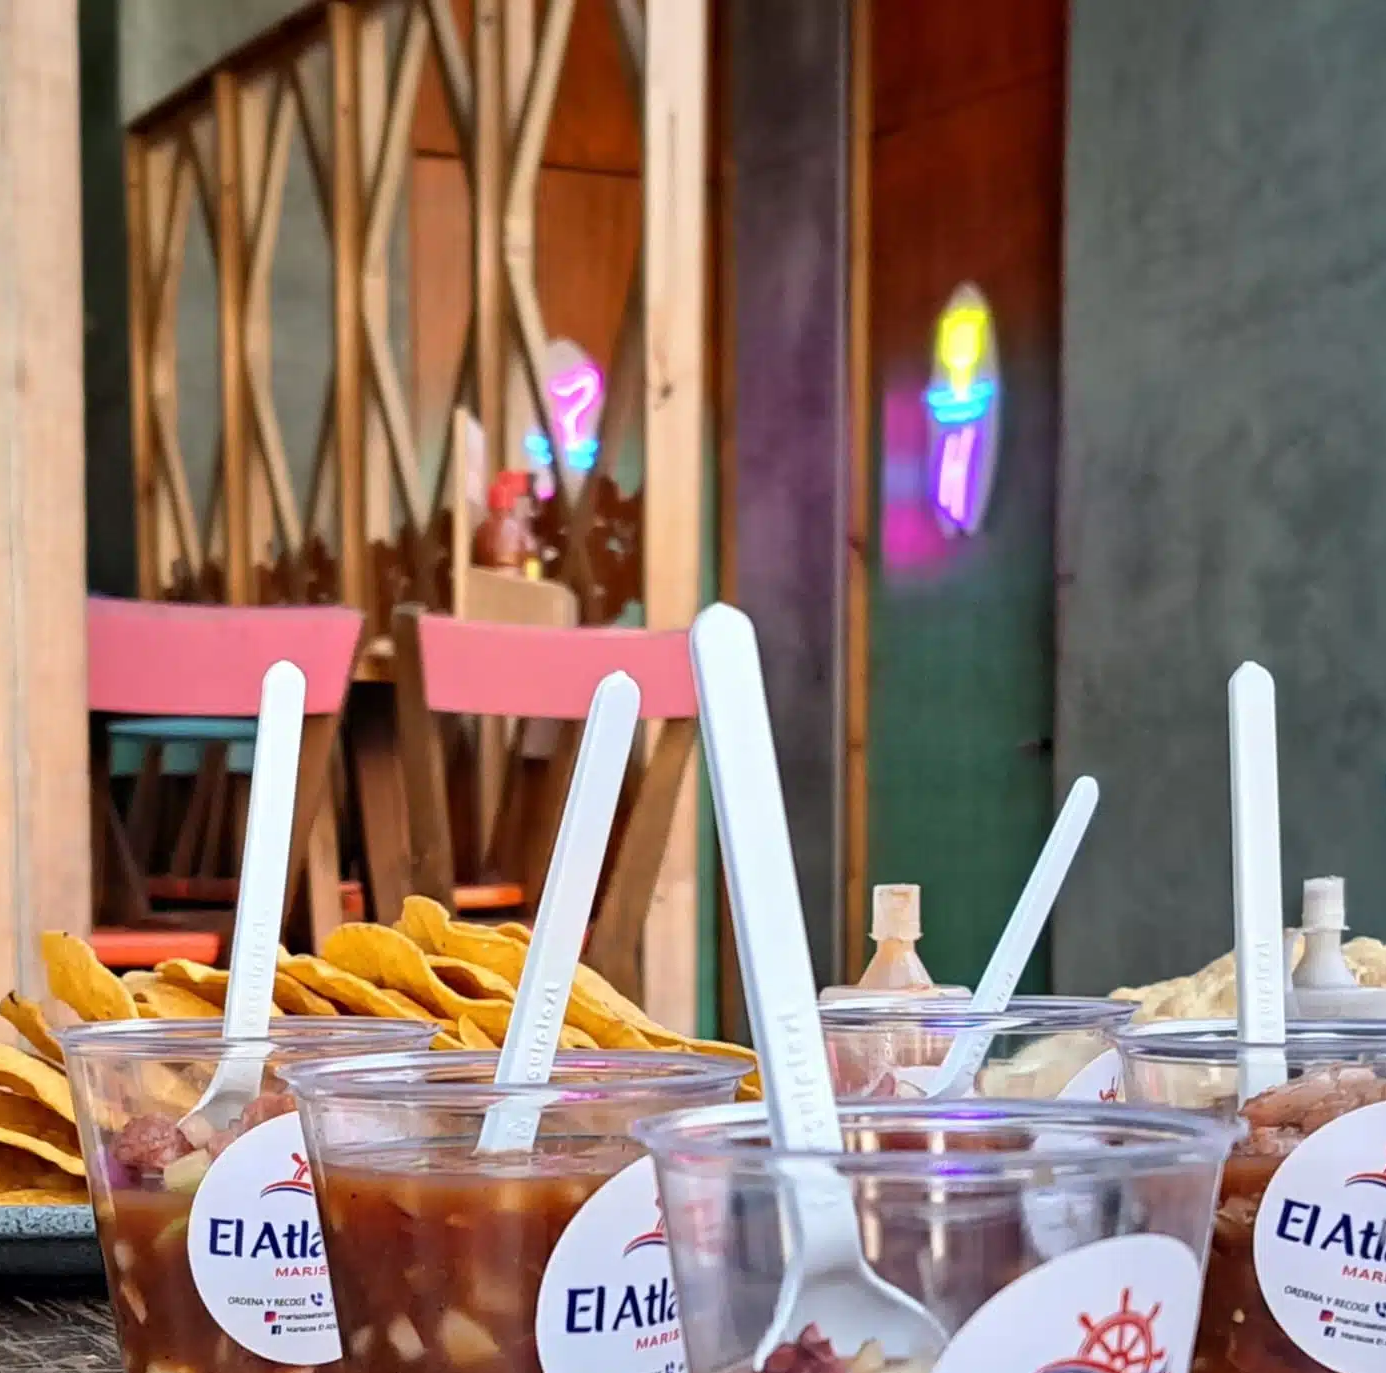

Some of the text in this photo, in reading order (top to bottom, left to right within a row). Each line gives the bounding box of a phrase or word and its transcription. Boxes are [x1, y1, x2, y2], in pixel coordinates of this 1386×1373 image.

[209, 1217, 244, 1258] El
[1276, 1198, 1321, 1247] El
[227, 1296, 265, 1306] ORDENA
[274, 1297, 306, 1306] RECOGE
[566, 1286, 606, 1333] El
[1284, 1285, 1323, 1303] ORDENA
